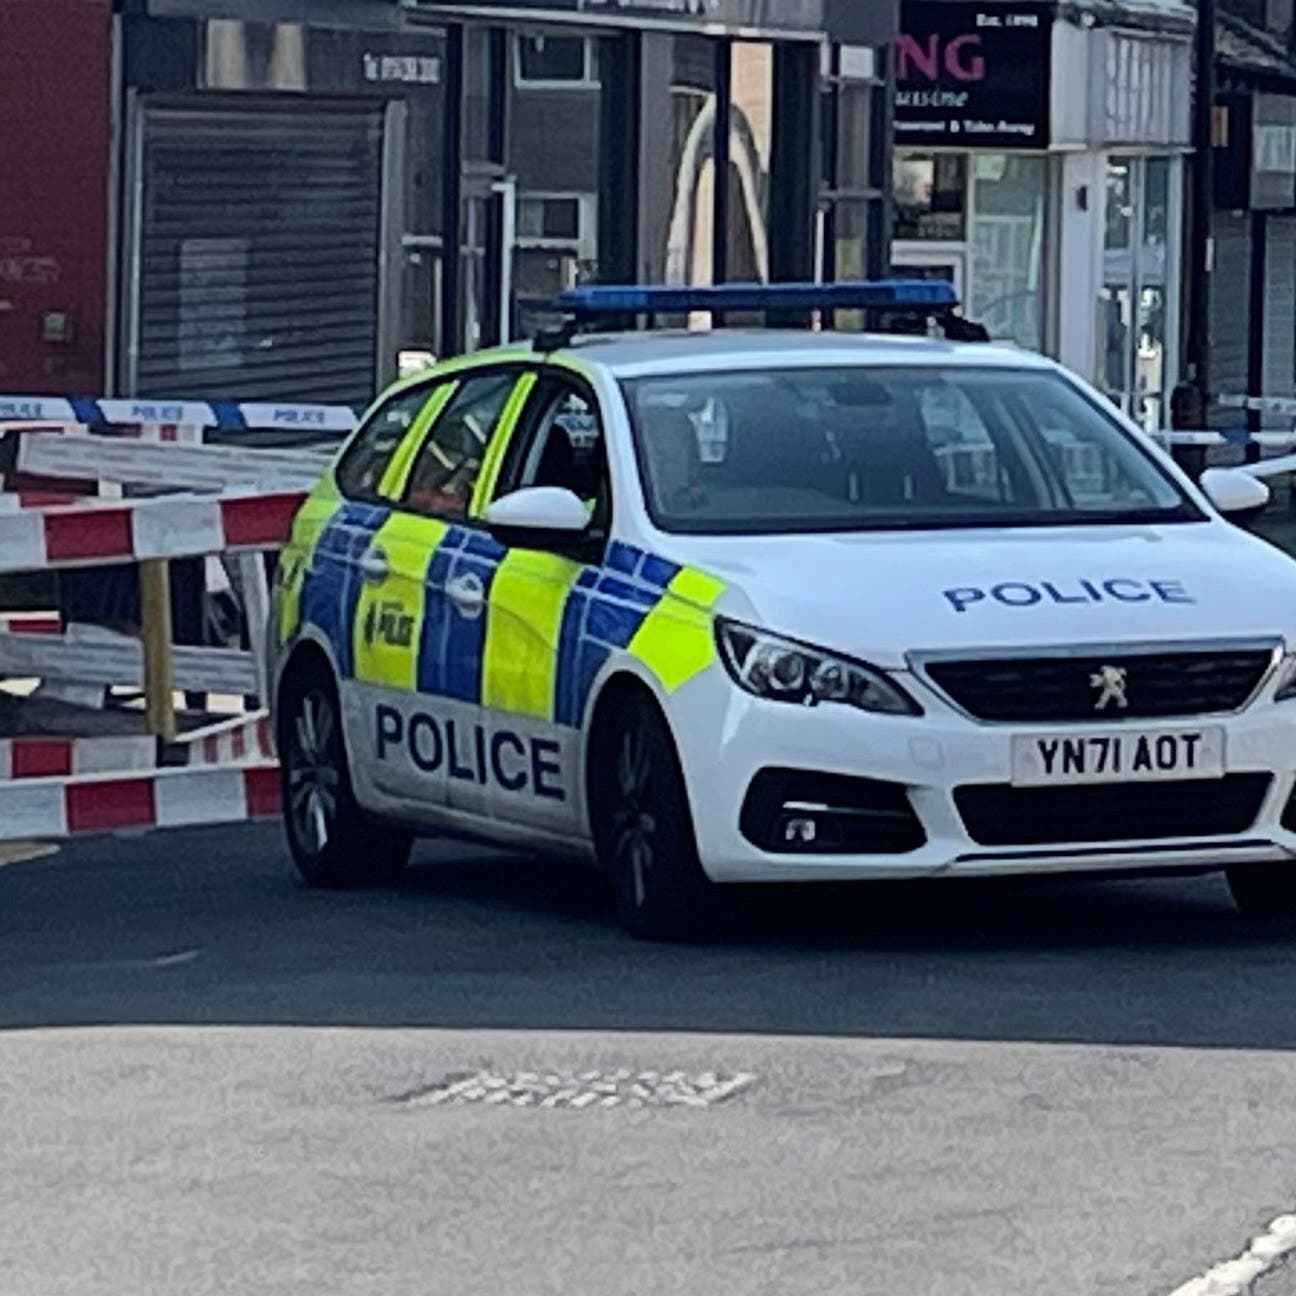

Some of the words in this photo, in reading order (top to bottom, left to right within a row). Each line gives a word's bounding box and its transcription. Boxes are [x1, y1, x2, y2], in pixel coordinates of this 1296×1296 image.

[896, 34, 986, 81] NG
[896, 89, 968, 107] uisine
[943, 578, 1197, 612] POLICE
[376, 704, 565, 802] POLICE
[1038, 737, 1121, 774] YN71
[1133, 735, 1200, 771] AOT
